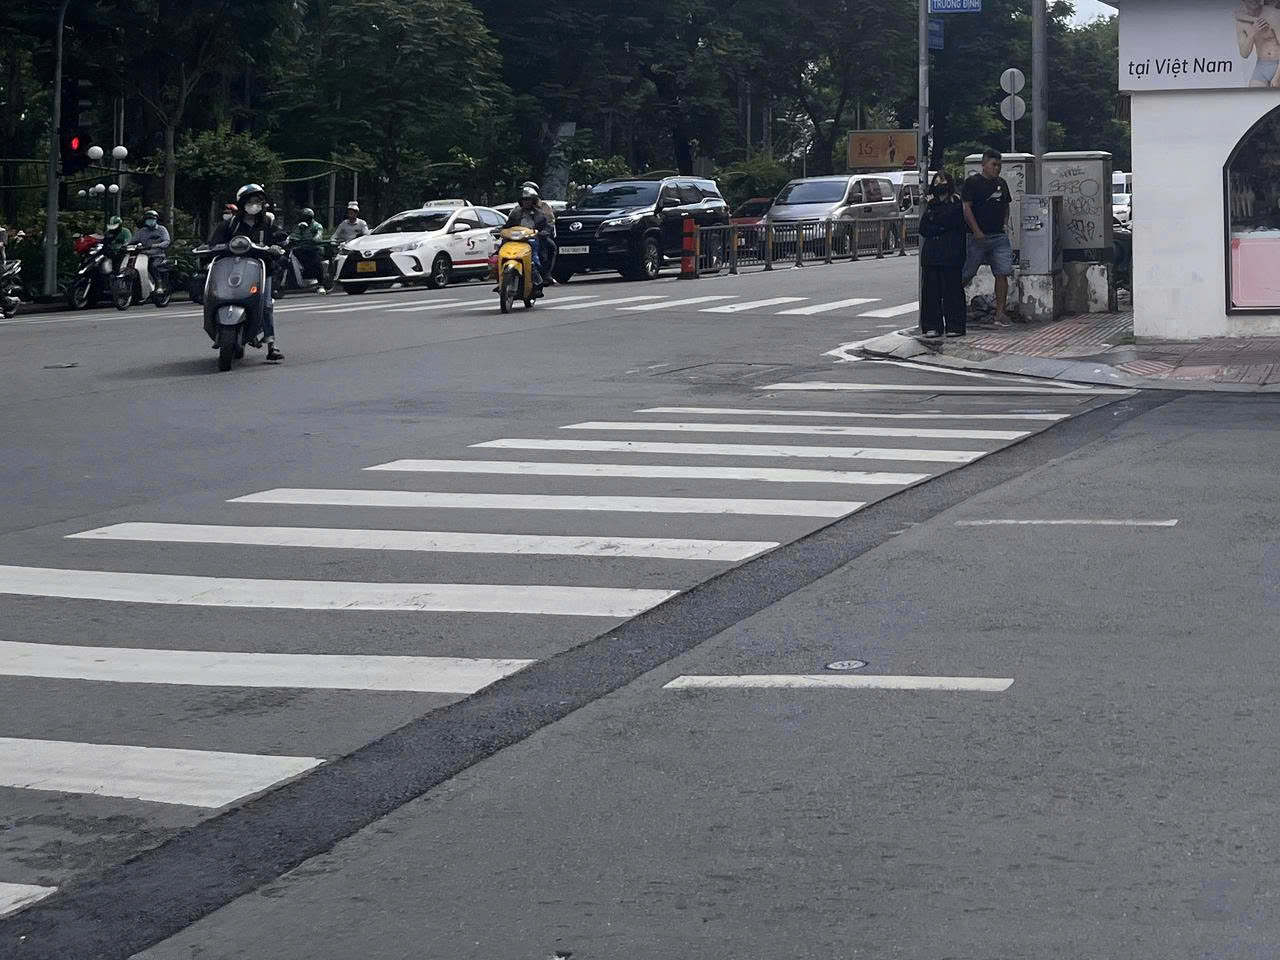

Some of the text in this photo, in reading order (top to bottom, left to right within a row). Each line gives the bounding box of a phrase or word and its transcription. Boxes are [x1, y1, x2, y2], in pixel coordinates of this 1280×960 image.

[1128, 56, 1233, 78] tại Việt Nam
